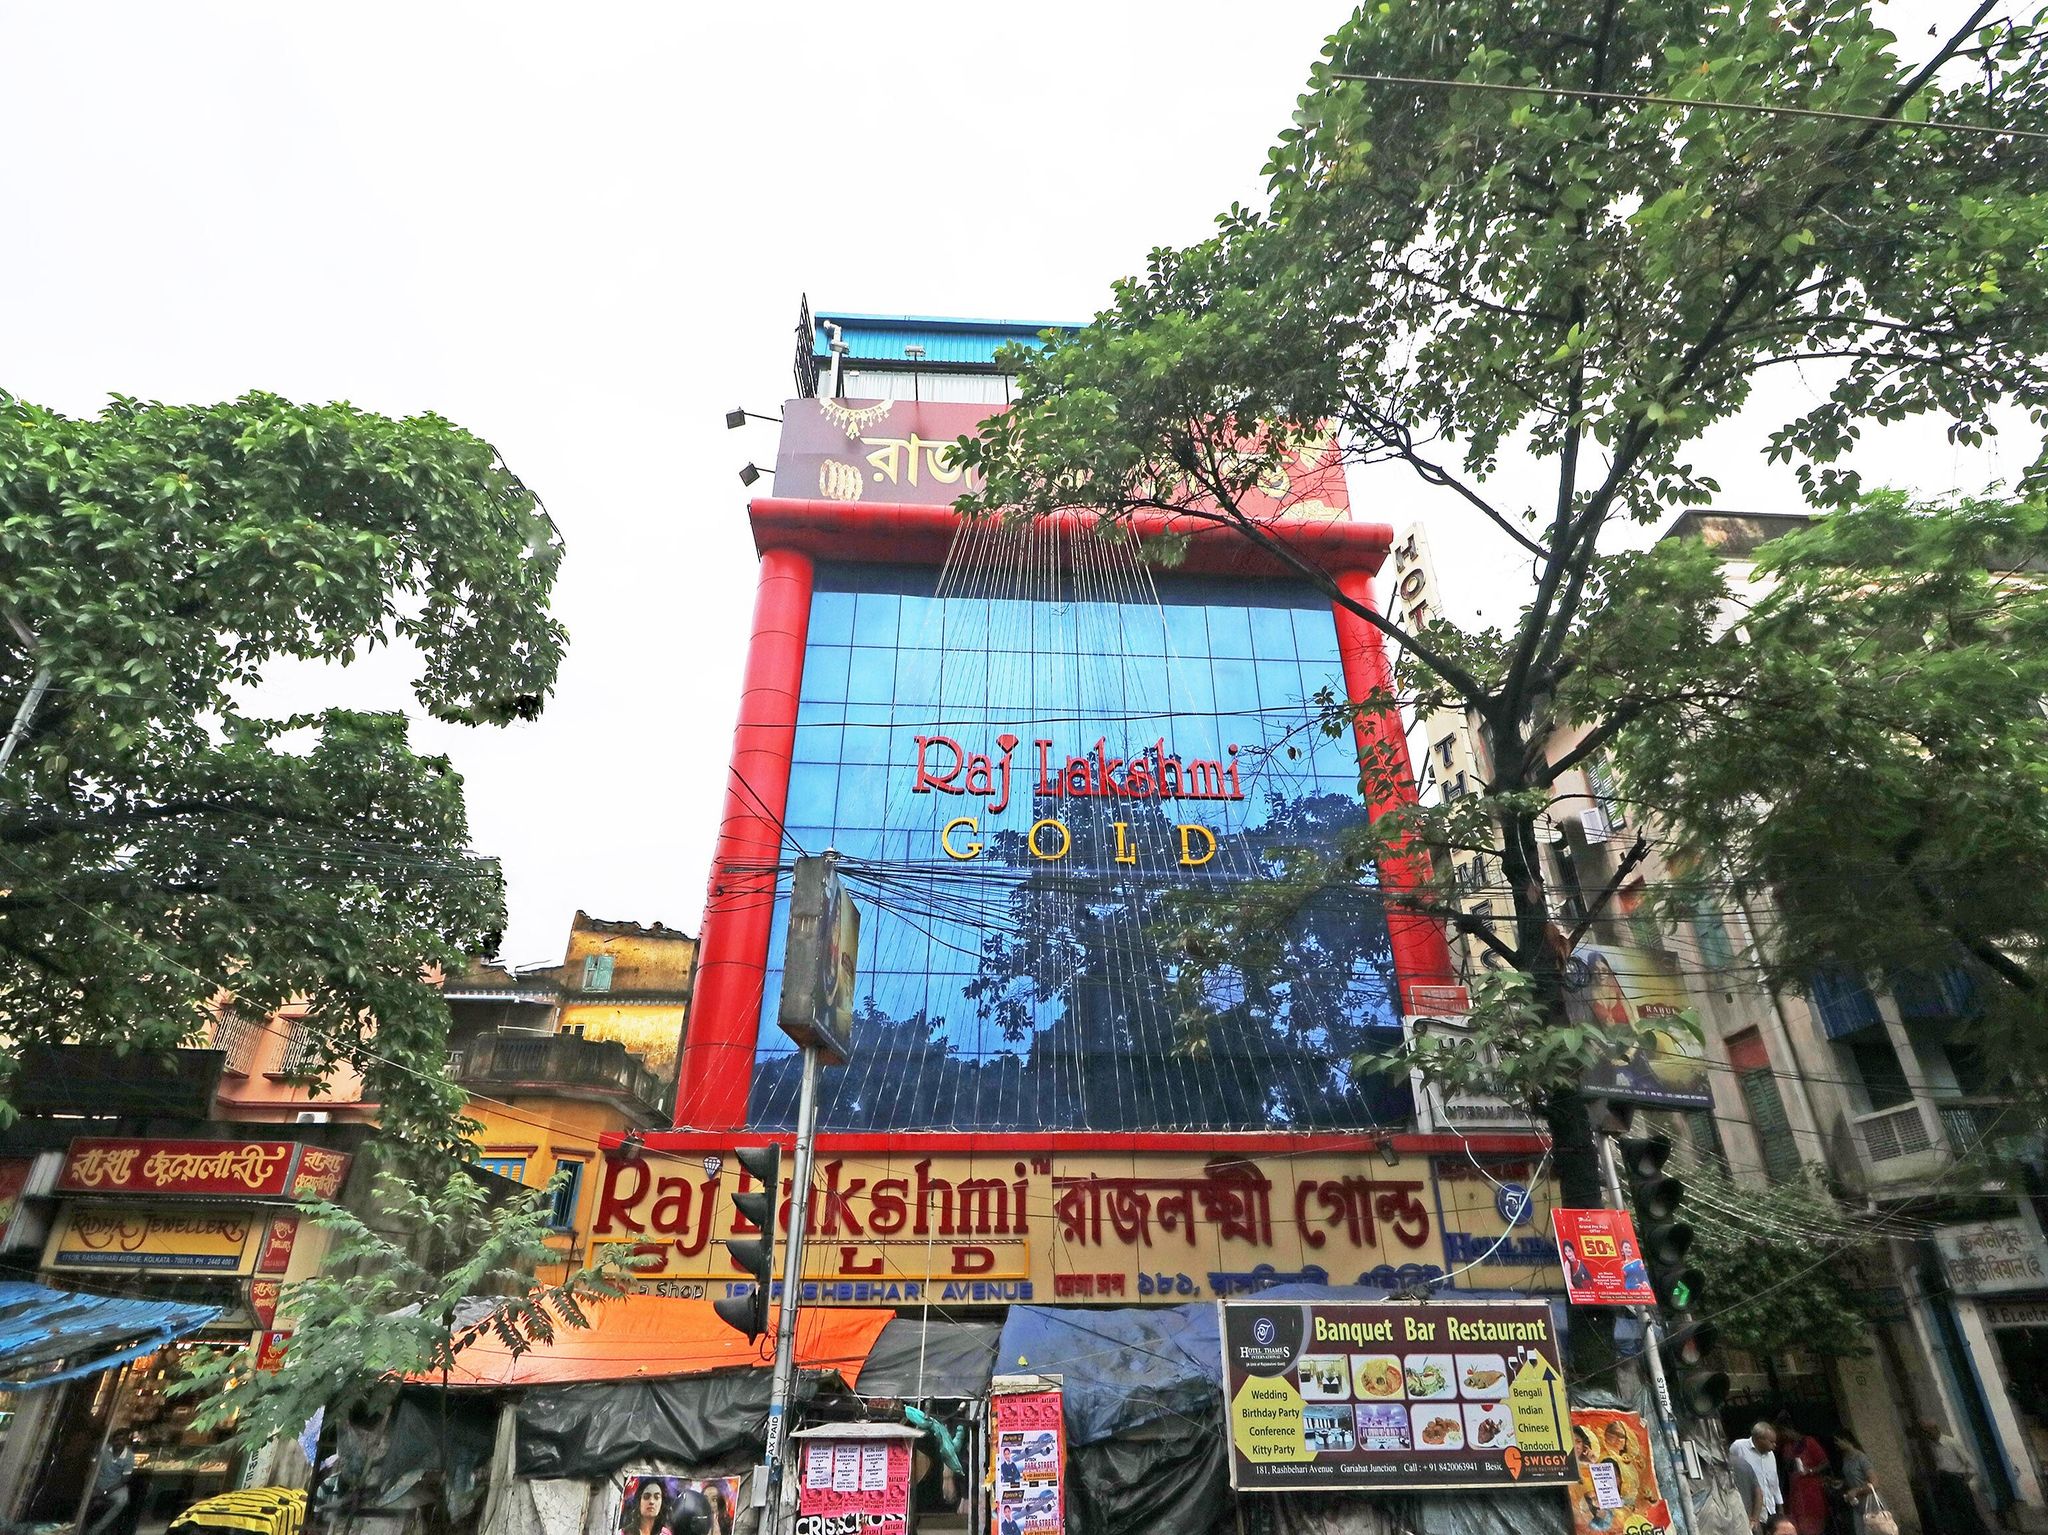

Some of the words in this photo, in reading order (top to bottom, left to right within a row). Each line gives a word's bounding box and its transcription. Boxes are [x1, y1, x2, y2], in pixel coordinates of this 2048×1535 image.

[912, 734, 1019, 814] Raj
[1034, 736, 1245, 800] Lakshmi
[941, 817, 1217, 865] GOLD
[72, 1147, 138, 1188] রাধা
[593, 1156, 722, 1258] Raj
[1296, 1174, 1430, 1248] গোল্ড
[144, 1256, 169, 1264] KOLKATA
[771, 1282, 925, 1300] RSHBEHARI
[941, 1281, 1033, 1300] AVENUE
[1315, 1316, 1393, 1347] Banquet
[1404, 1317, 1435, 1342] Bar
[1447, 1316, 1547, 1342] Restaurant
[1240, 1346, 1262, 1358] HOTEL
[1251, 1389, 1287, 1401] Wedding
[1513, 1388, 1543, 1399] Bengali
[1242, 1408, 1277, 1420] Birthday
[1278, 1407, 1300, 1419] Party
[1518, 1405, 1543, 1415] Indian
[770, 1416, 779, 1439] PAID
[1249, 1426, 1296, 1436] Conference
[1518, 1423, 1549, 1433] Chinese
[1252, 1445, 1272, 1457] Kitty
[1273, 1444, 1296, 1456] Party
[1519, 1440, 1554, 1451] Tandoori
[1524, 1455, 1567, 1466] SWIGGY
[1256, 1465, 1270, 1475] 181,
[1271, 1464, 1308, 1475] Rashbehari
[1309, 1464, 1334, 1474] Avenue
[1340, 1463, 1369, 1474] Gariahat
[1370, 1463, 1397, 1473] Junction
[1403, 1463, 1418, 1473] Call
